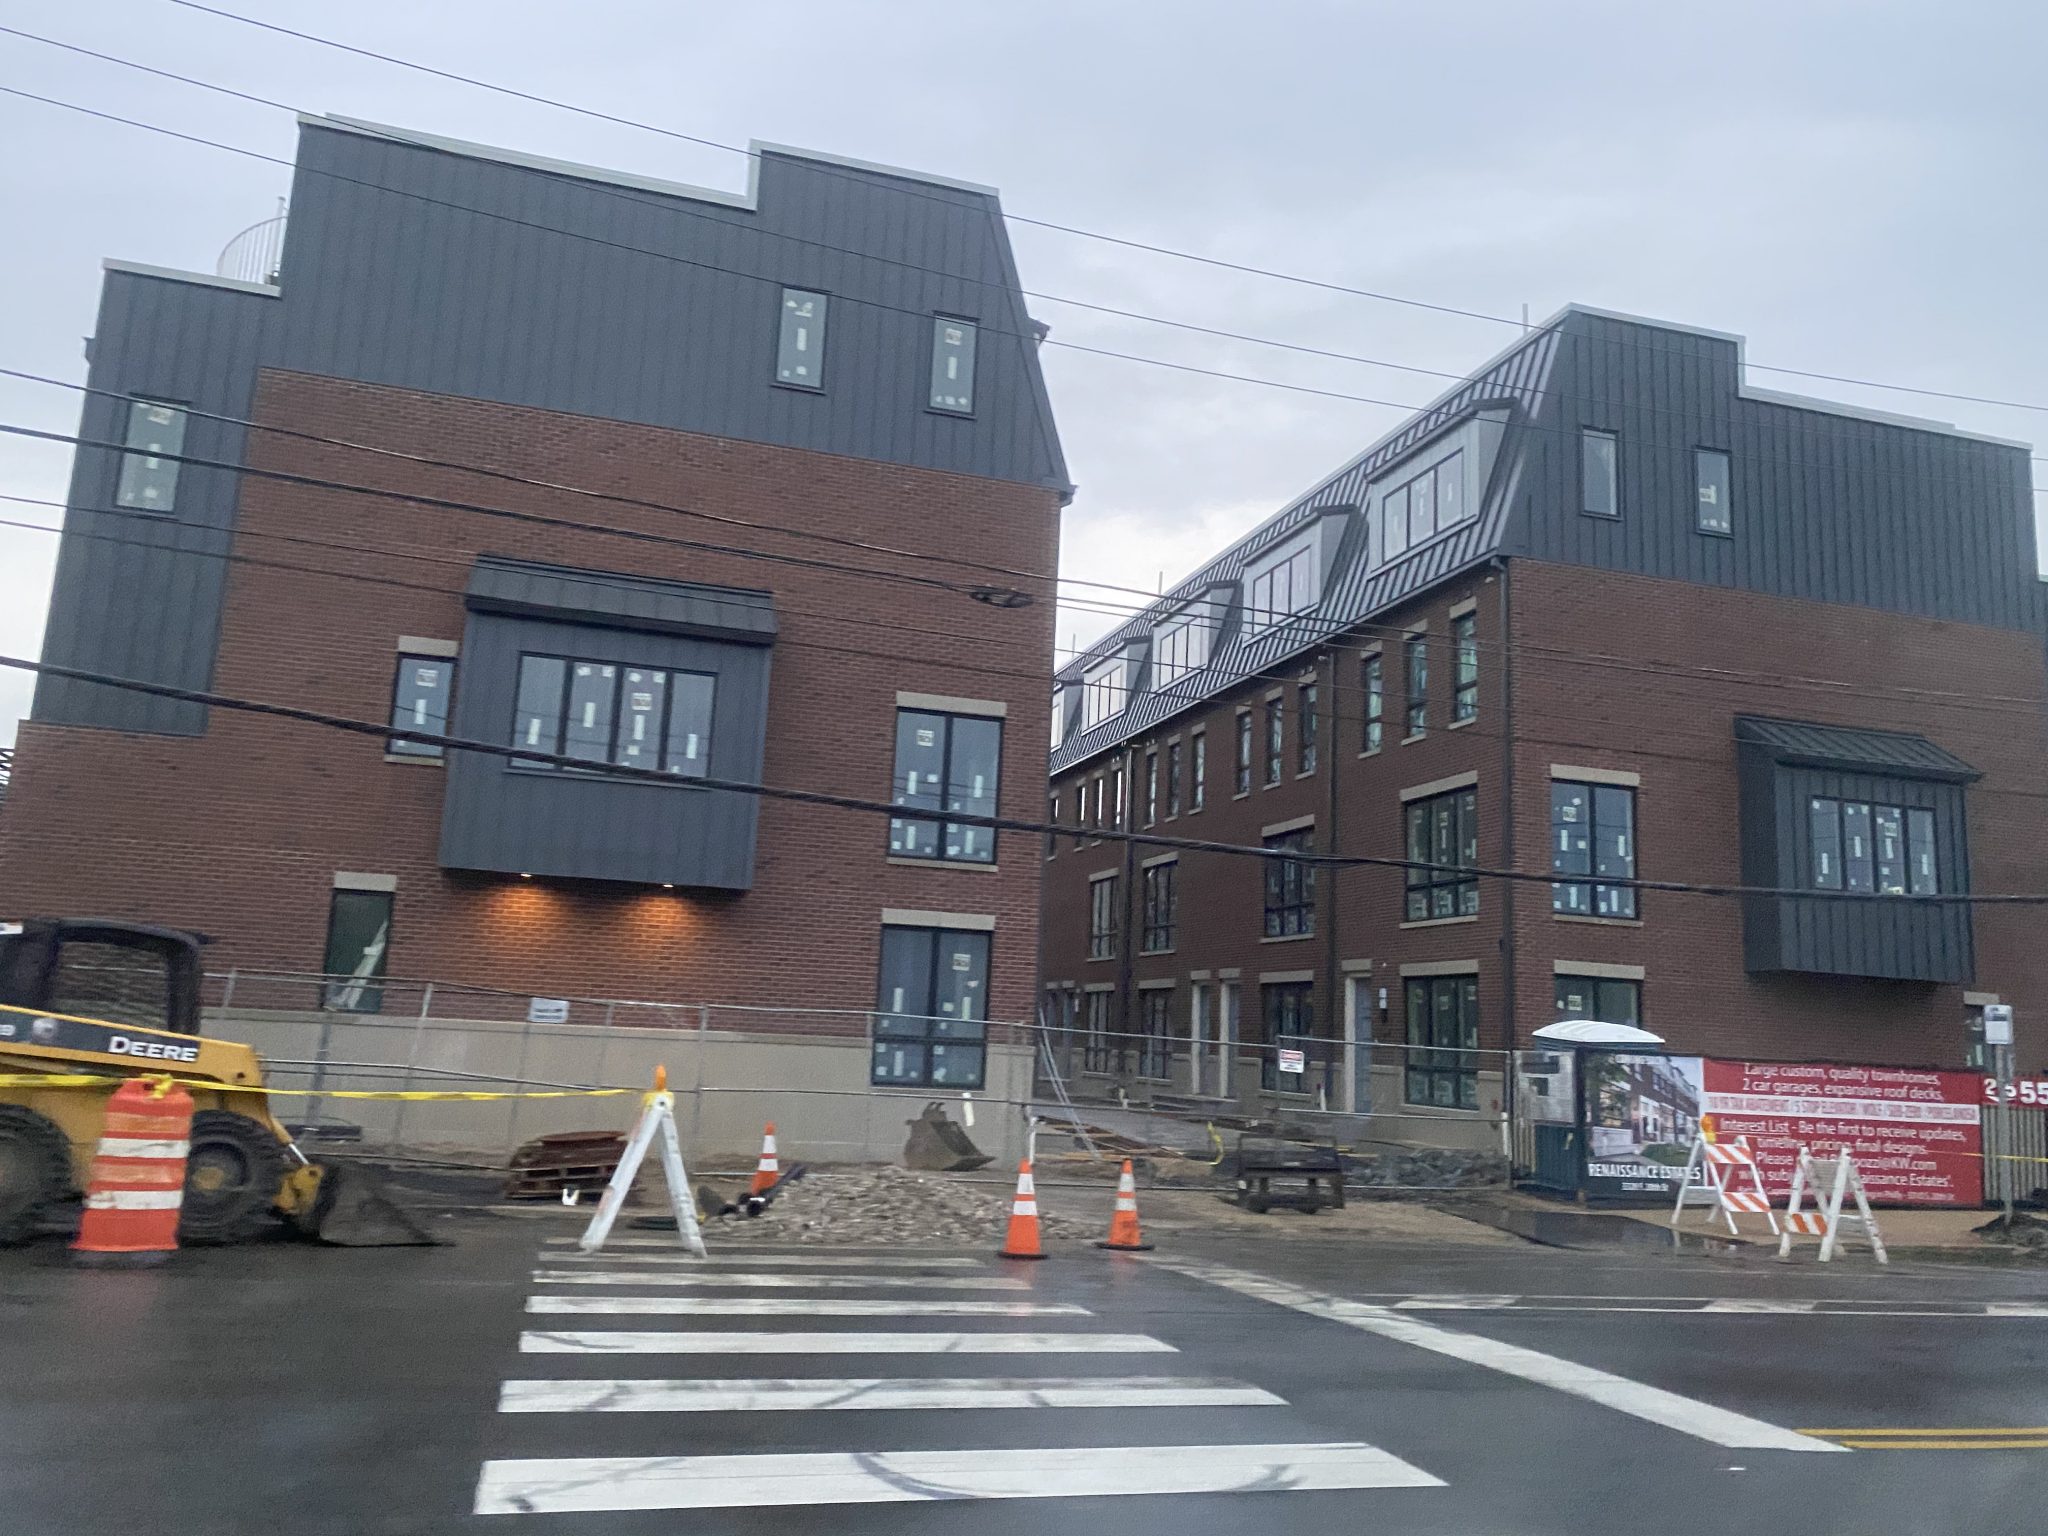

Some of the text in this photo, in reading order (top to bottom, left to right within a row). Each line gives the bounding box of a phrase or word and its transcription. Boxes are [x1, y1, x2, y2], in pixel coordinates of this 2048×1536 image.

[108, 1035, 198, 1062] DEERE
[1744, 1062, 1941, 1085] Large custom, quality townhomes,
[1742, 1078, 1750, 1091] 2
[1751, 1081, 1771, 1091] car
[1824, 1083, 1882, 1098] expansive
[1884, 1085, 1908, 1098] roof
[1720, 1117, 1766, 1133] Interest
[1768, 1119, 1789, 1134] List
[1798, 1121, 1814, 1134] Be
[1815, 1121, 1836, 1135] the
[1837, 1122, 1859, 1136] first
[1861, 1125, 1875, 1136] to
[1877, 1126, 1917, 1138] receive
[1919, 1127, 1967, 1142] updates,
[1856, 1139, 1880, 1152] final
[1756, 1151, 1794, 1166] Please
[1588, 1163, 1701, 1180] RENAISSANCE ESTAES
